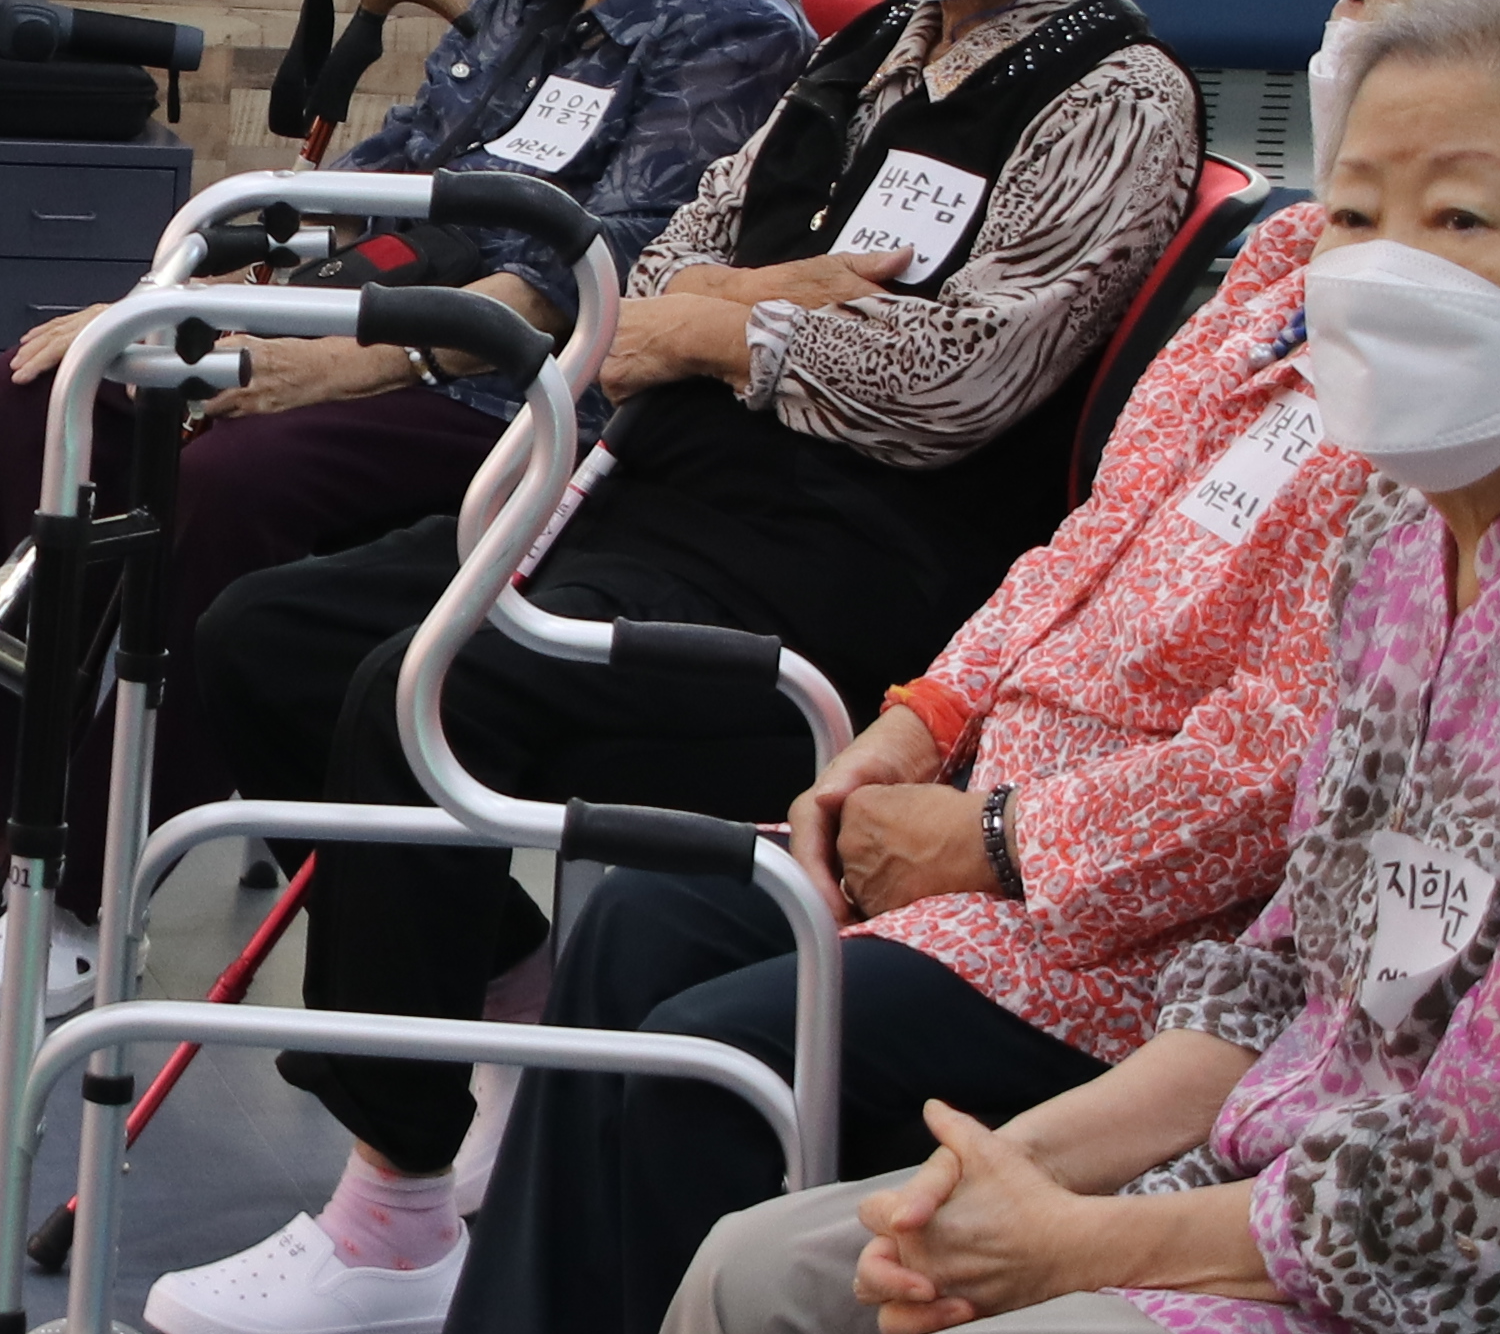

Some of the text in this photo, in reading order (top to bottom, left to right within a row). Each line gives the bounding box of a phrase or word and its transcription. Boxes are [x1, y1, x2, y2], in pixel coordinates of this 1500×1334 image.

[537, 89, 600, 131] 유을숙
[506, 138, 556, 161] 어르신
[878, 166, 967, 224] 박순남
[1196, 479, 1259, 528] 어르신
[1382, 861, 1469, 952] 지희순
